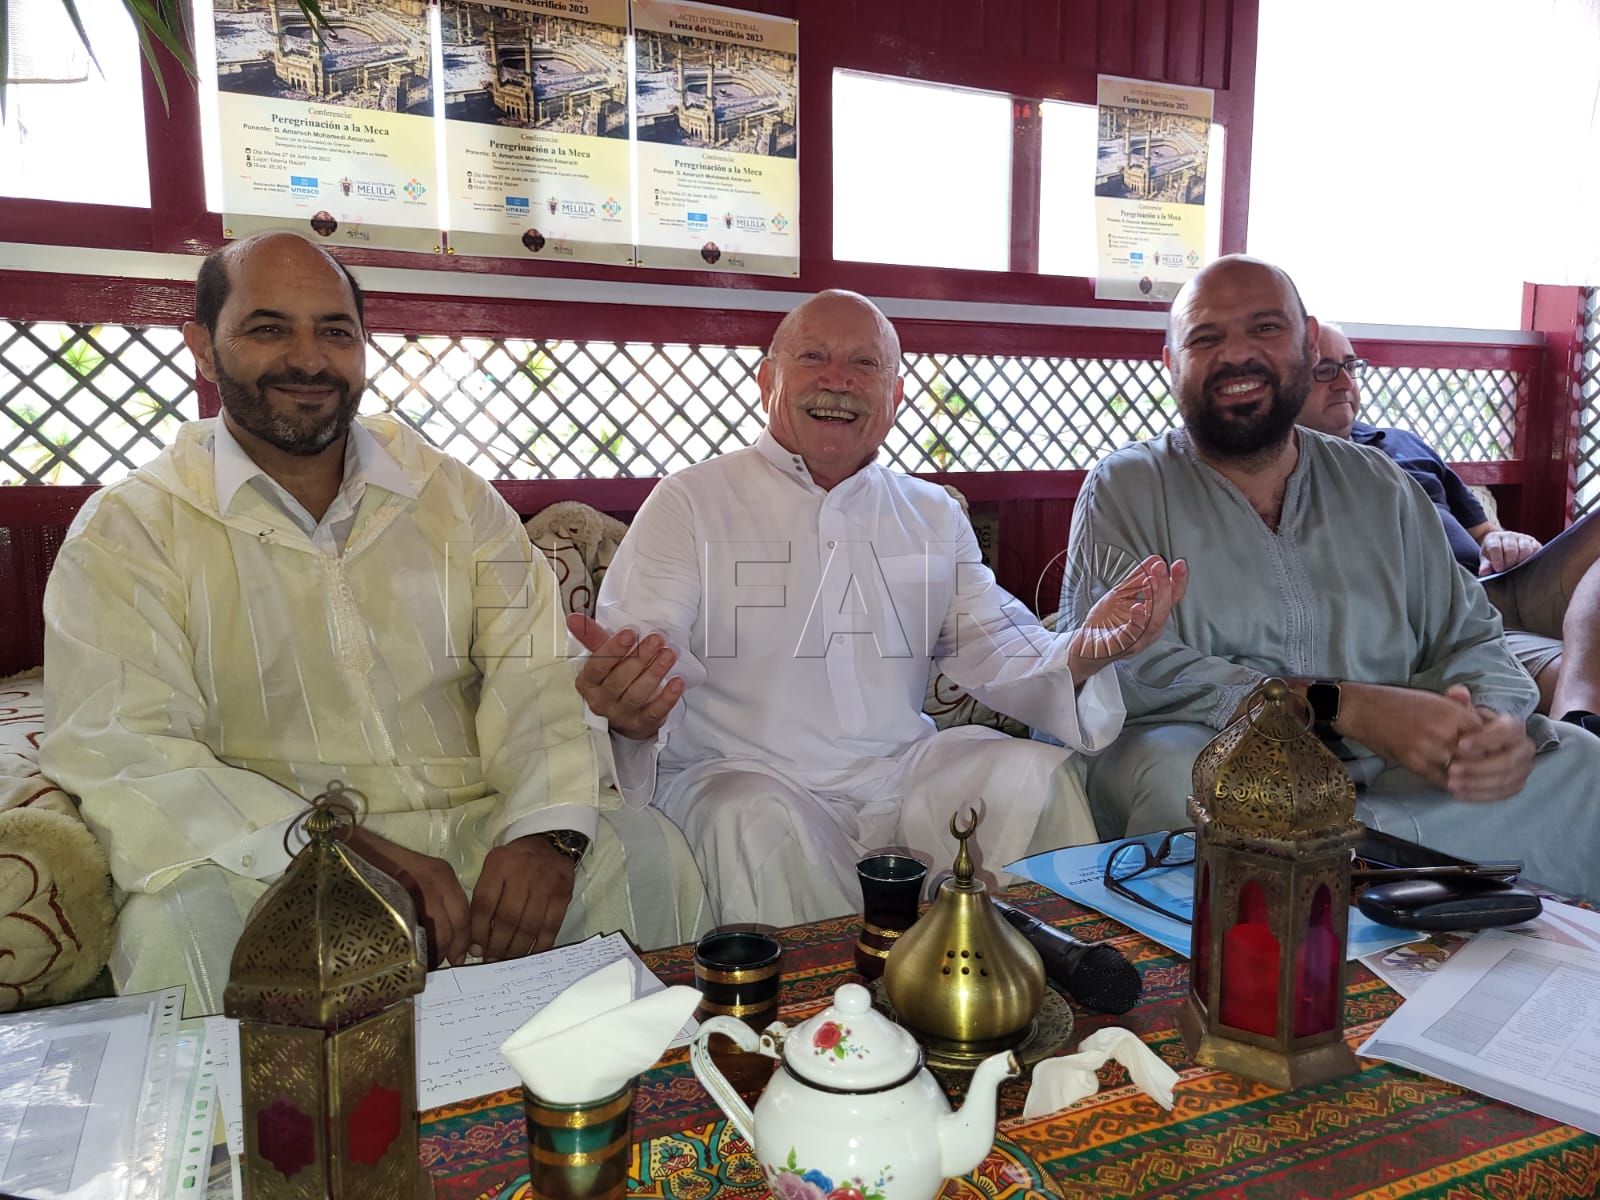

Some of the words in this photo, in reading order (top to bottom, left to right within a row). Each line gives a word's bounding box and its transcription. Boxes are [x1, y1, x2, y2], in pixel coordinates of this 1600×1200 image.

[569, 4, 589, 15] 2023
[679, 13, 698, 22] ACTO
[669, 20, 693, 31] Fiesta
[694, 24, 707, 33] del
[708, 26, 745, 40] Sacrificio
[746, 33, 763, 42] 2023
[308, 106, 352, 119] Conferencia:
[243, 123, 272, 133] Ponente:
[271, 113, 341, 131] Peregrinación
[352, 124, 361, 133] la
[364, 125, 390, 136] Meca
[489, 139, 549, 154] Peregrinación
[558, 147, 565, 156] la
[568, 148, 591, 158] Meca
[675, 159, 726, 173] Peregrinación
[734, 166, 741, 174] la
[743, 167, 762, 176] Meca
[291, 187, 320, 195] unesco
[357, 184, 397, 196] MELILLA
[562, 204, 596, 214] MELILLA
